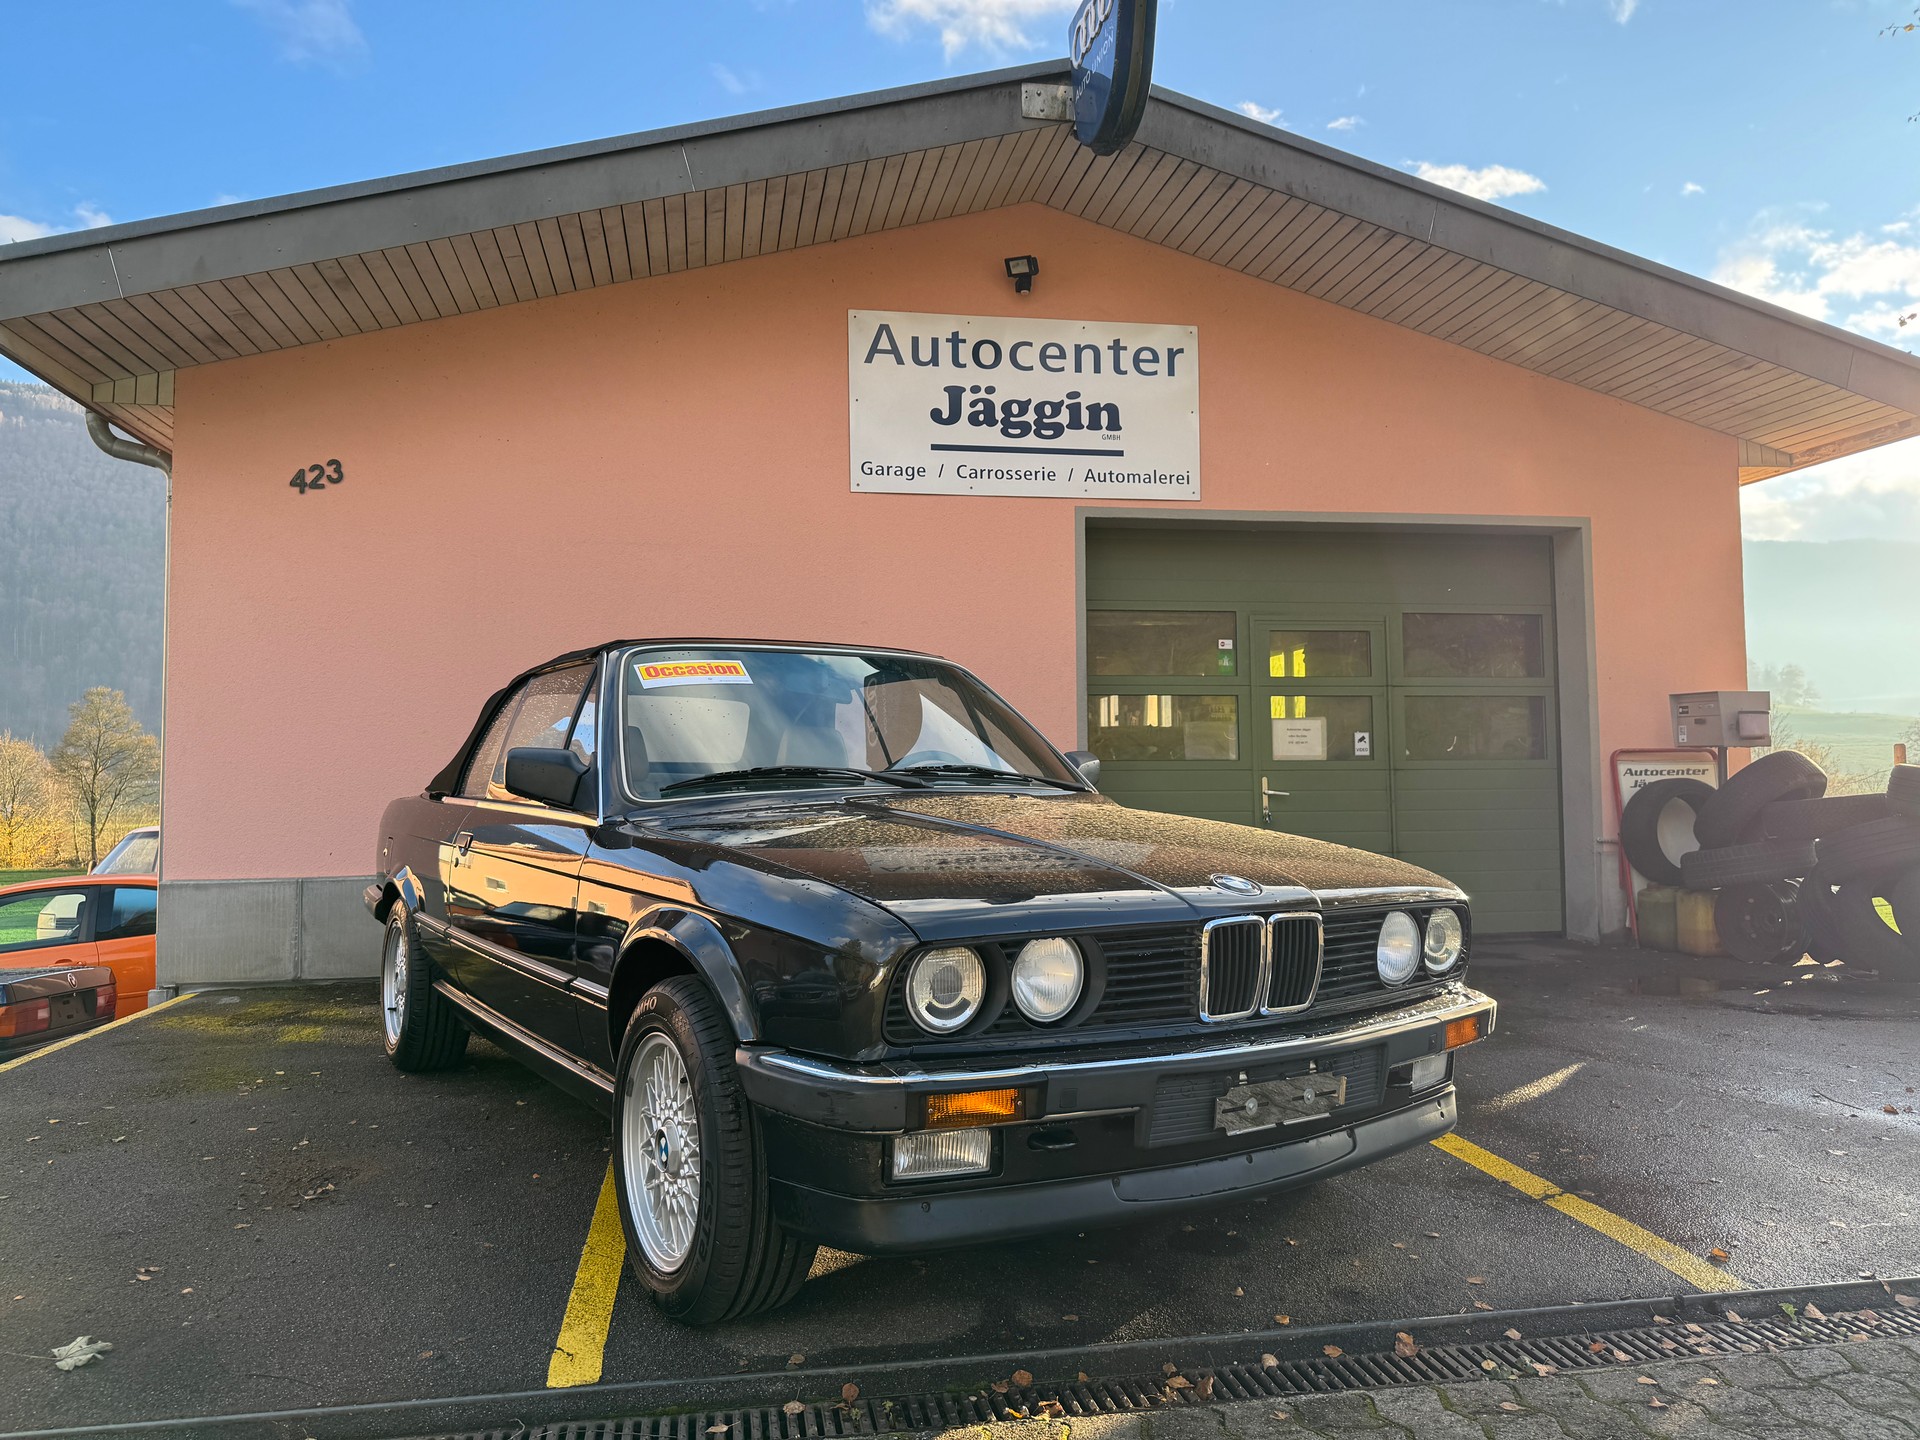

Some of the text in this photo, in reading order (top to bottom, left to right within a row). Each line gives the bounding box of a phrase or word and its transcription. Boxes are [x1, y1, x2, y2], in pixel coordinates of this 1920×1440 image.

[1075, 70, 1091, 103] AUTO
[863, 323, 1185, 377] Autocenter
[929, 385, 1123, 440] Jäggin
[1101, 433, 1121, 441] GMBH
[289, 458, 344, 494] 423
[860, 461, 1191, 485] Garage / Carrosserie / Automalerei
[644, 662, 741, 678] Occasion
[1623, 768, 1709, 776] Autocenter
